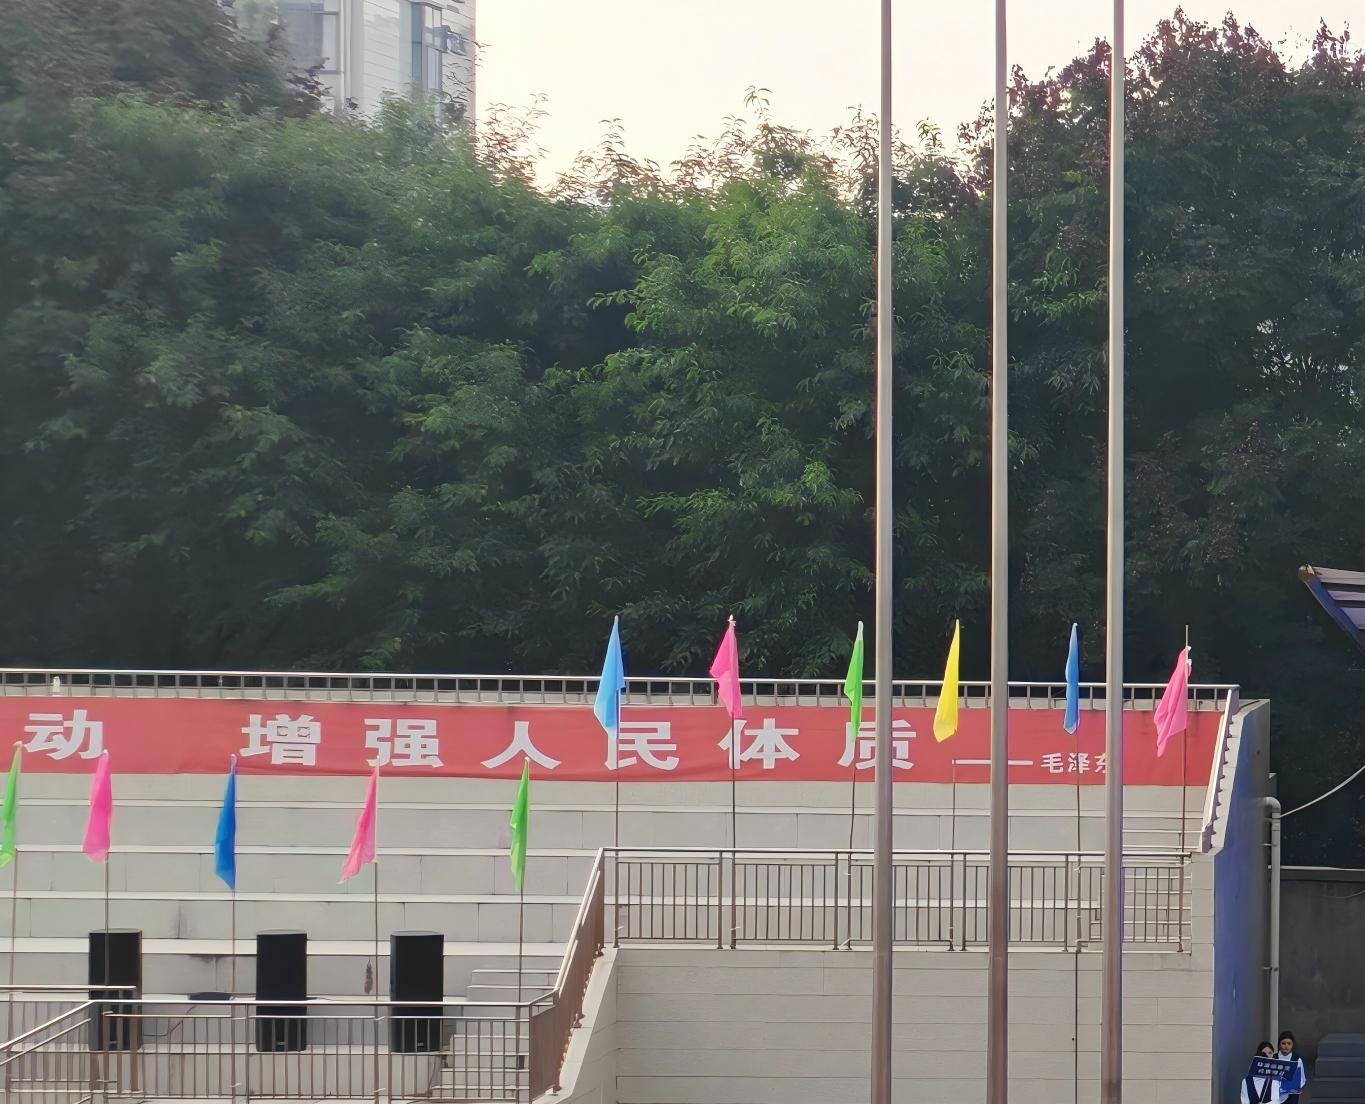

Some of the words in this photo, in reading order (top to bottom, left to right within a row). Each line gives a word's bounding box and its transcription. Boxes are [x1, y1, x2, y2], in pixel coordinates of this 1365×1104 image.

[24, 709, 104, 760] 动
[239, 714, 917, 771] 增强人民体质
